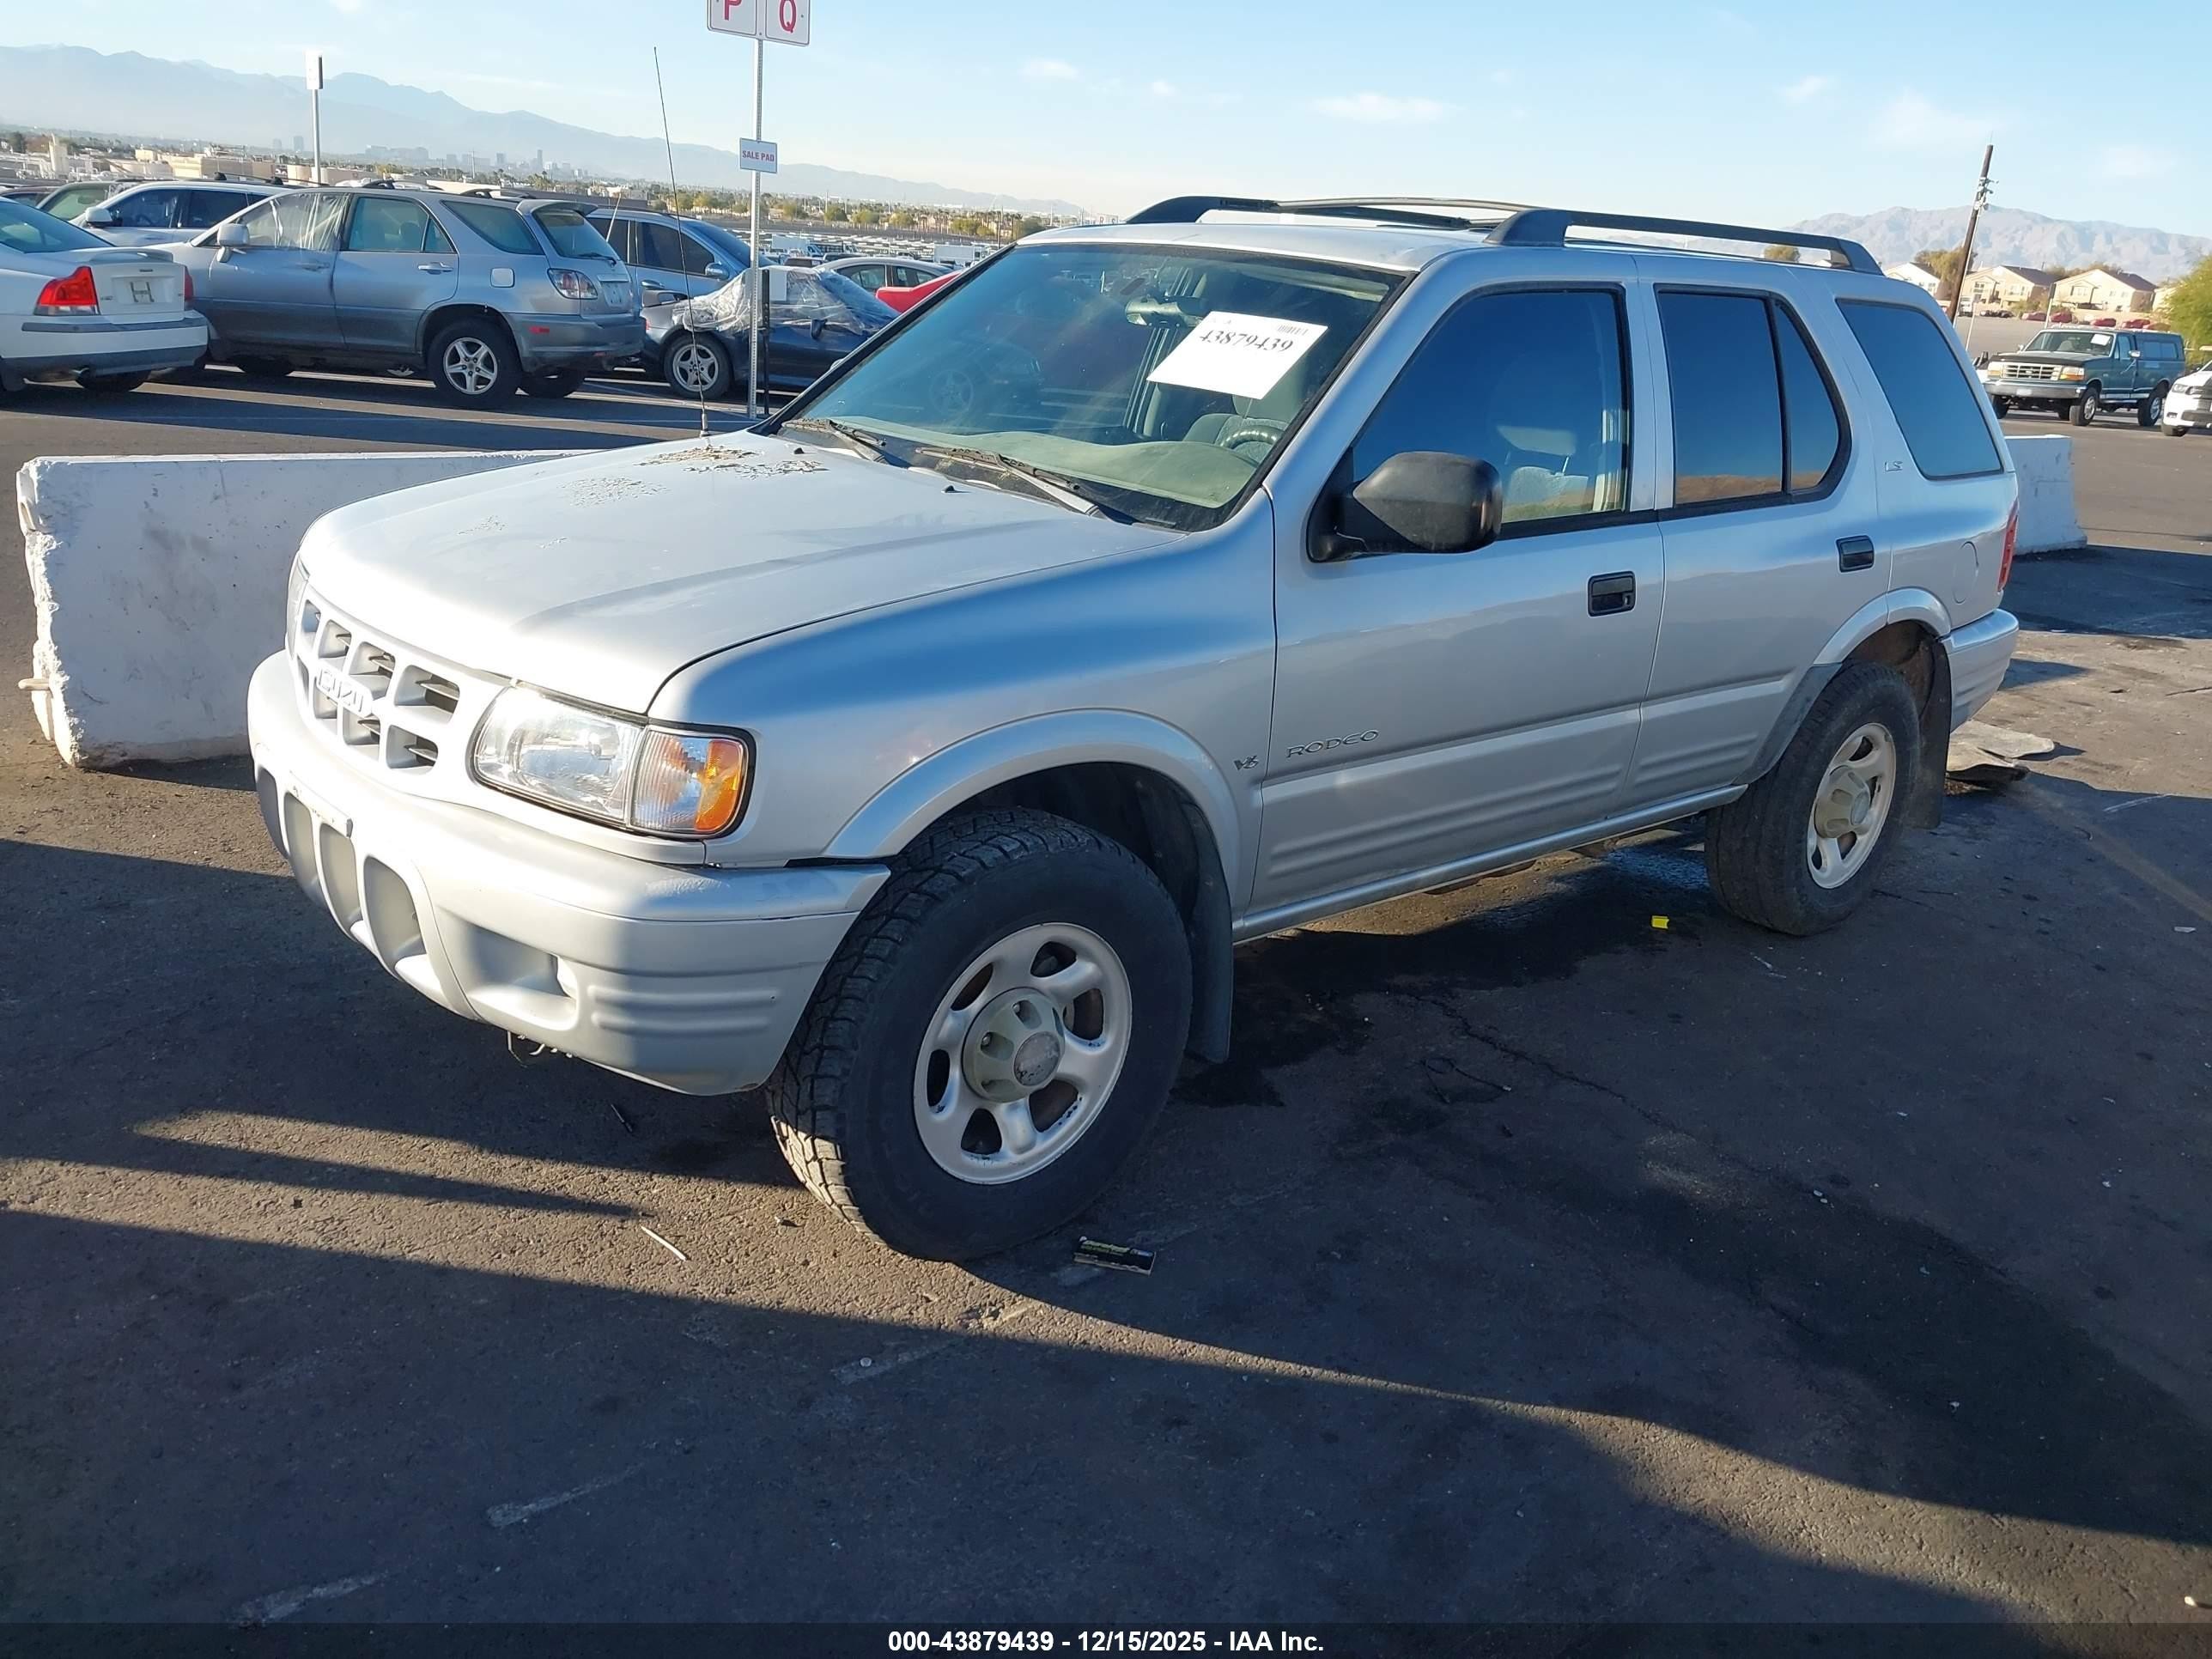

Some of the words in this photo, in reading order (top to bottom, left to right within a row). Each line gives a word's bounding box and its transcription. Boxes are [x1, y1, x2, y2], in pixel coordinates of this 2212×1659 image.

[779, 0, 797, 33] Q
[742, 150, 760, 160] SALE
[761, 152, 775, 162] PAD
[1200, 329, 1294, 353] 43879439
[1884, 460, 1903, 472] LS
[1286, 729, 1379, 758] RODEO
[1234, 755, 1259, 771] V6
